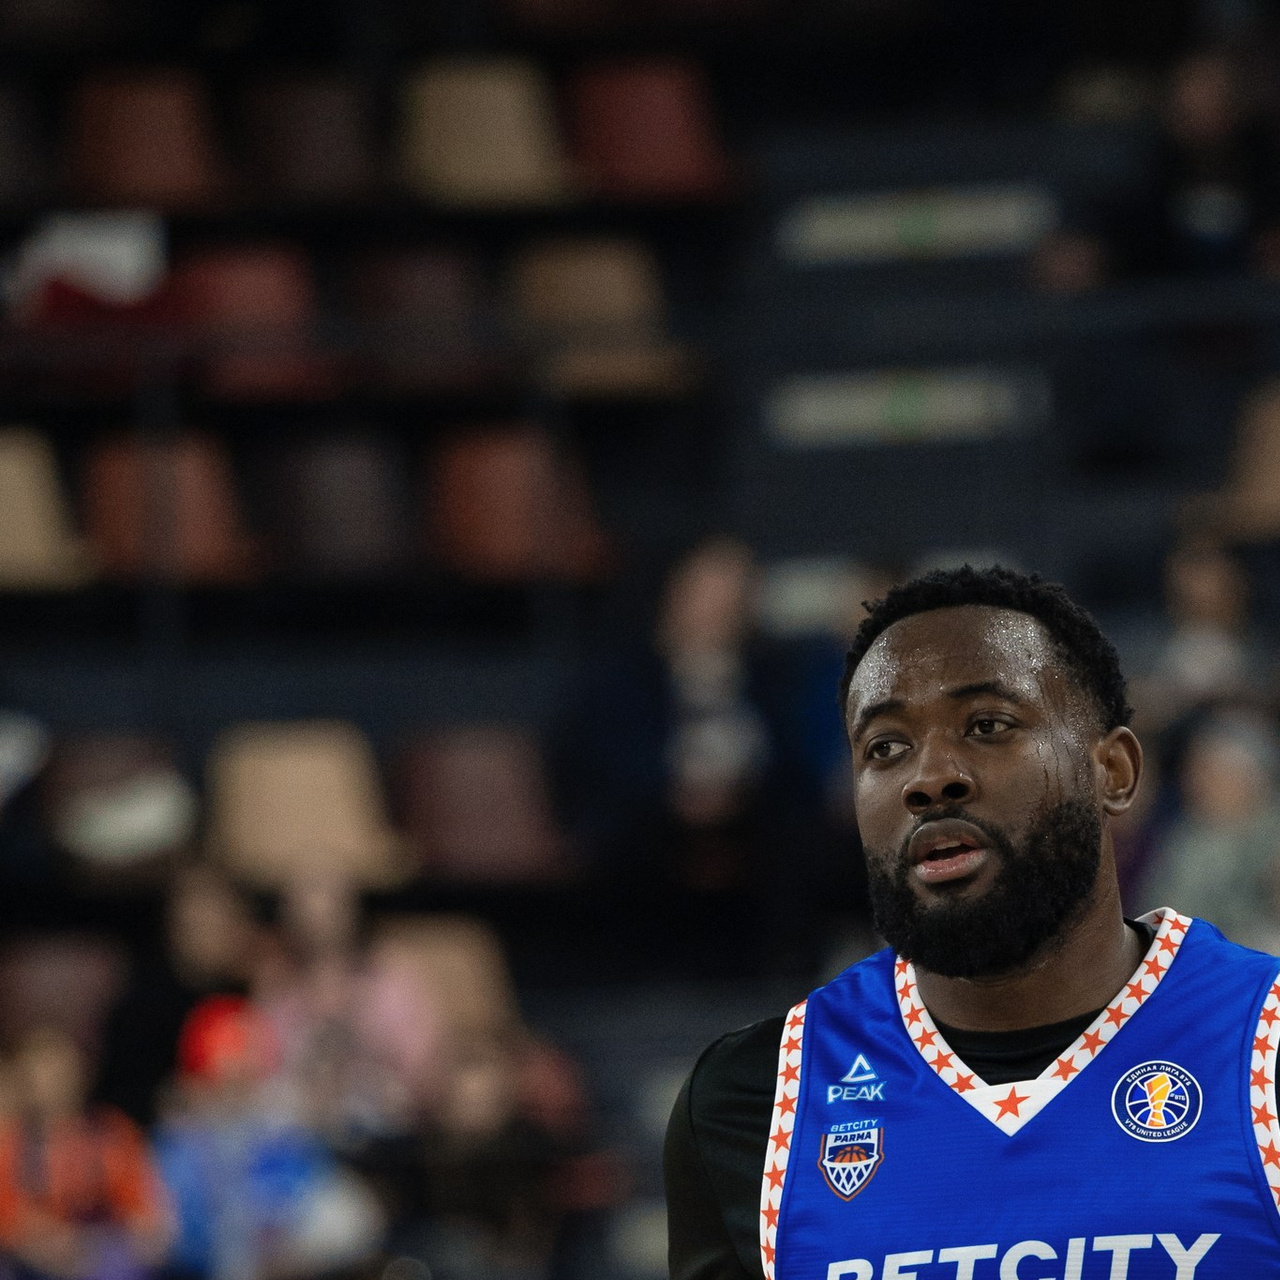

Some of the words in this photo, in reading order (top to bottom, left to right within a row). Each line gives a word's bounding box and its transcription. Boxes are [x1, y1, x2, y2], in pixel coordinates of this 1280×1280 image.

[1126, 1065, 1157, 1083] ЕДИНАЯ
[1160, 1065, 1179, 1076] ЛИГА
[827, 1081, 887, 1105] PEAK
[830, 1119, 878, 1133] BETCITY
[1125, 1118, 1136, 1130] VTB
[1136, 1127, 1162, 1138] UNITED
[1163, 1121, 1188, 1137] LEAGUE
[834, 1131, 872, 1143] PARMA
